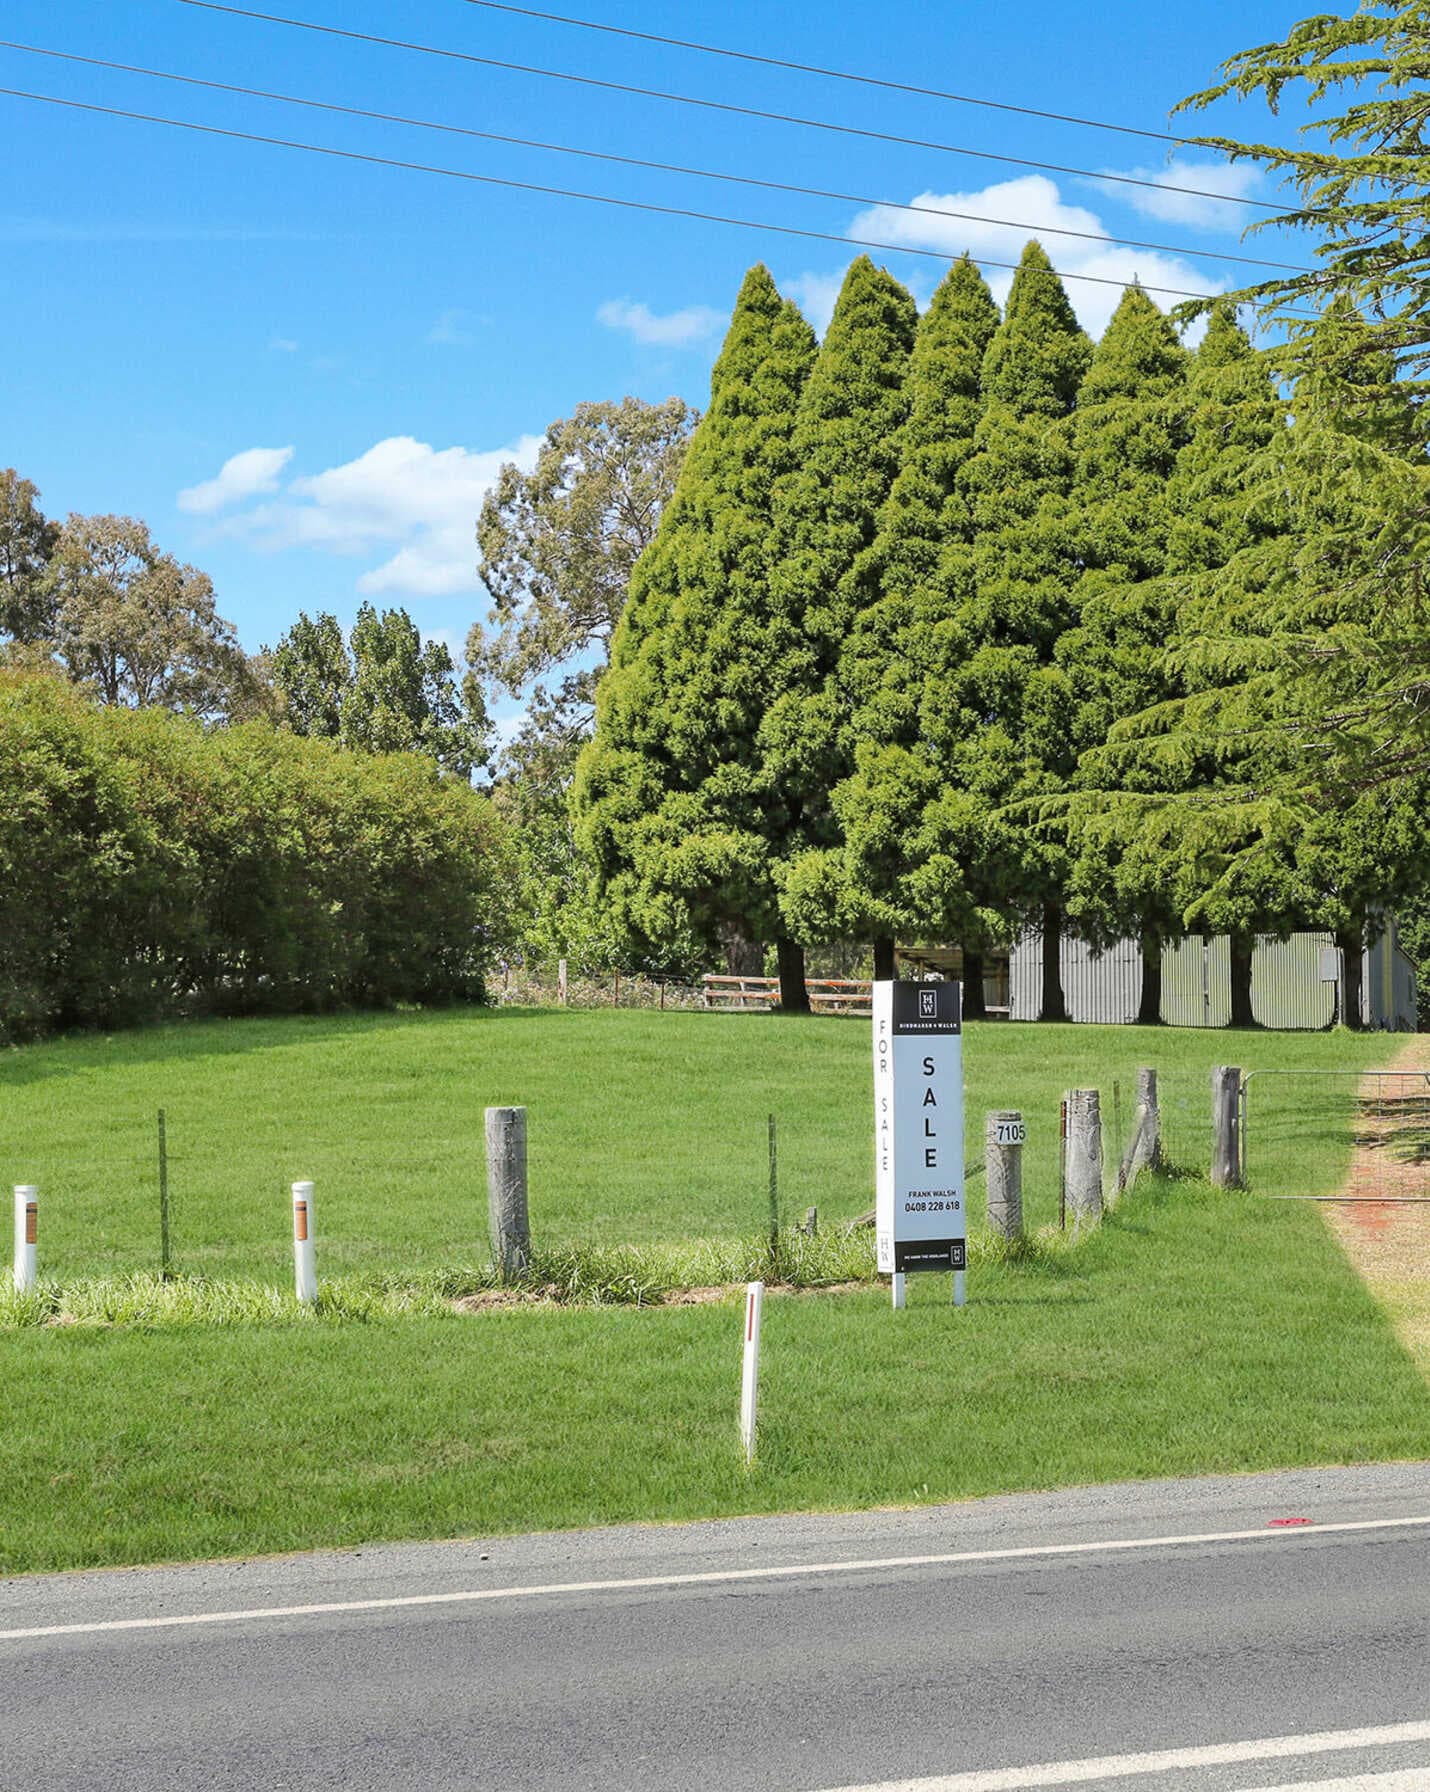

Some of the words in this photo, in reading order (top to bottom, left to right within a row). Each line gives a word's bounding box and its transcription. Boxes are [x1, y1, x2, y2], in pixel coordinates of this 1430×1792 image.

[879, 1019, 888, 1073] FOR
[881, 1097, 889, 1171] SALE
[923, 1056, 937, 1168] SALE
[997, 1124, 1026, 1141] 7105
[905, 1202, 927, 1212] 0408
[928, 1201, 944, 1211] 228
[946, 1200, 960, 1210] 618
